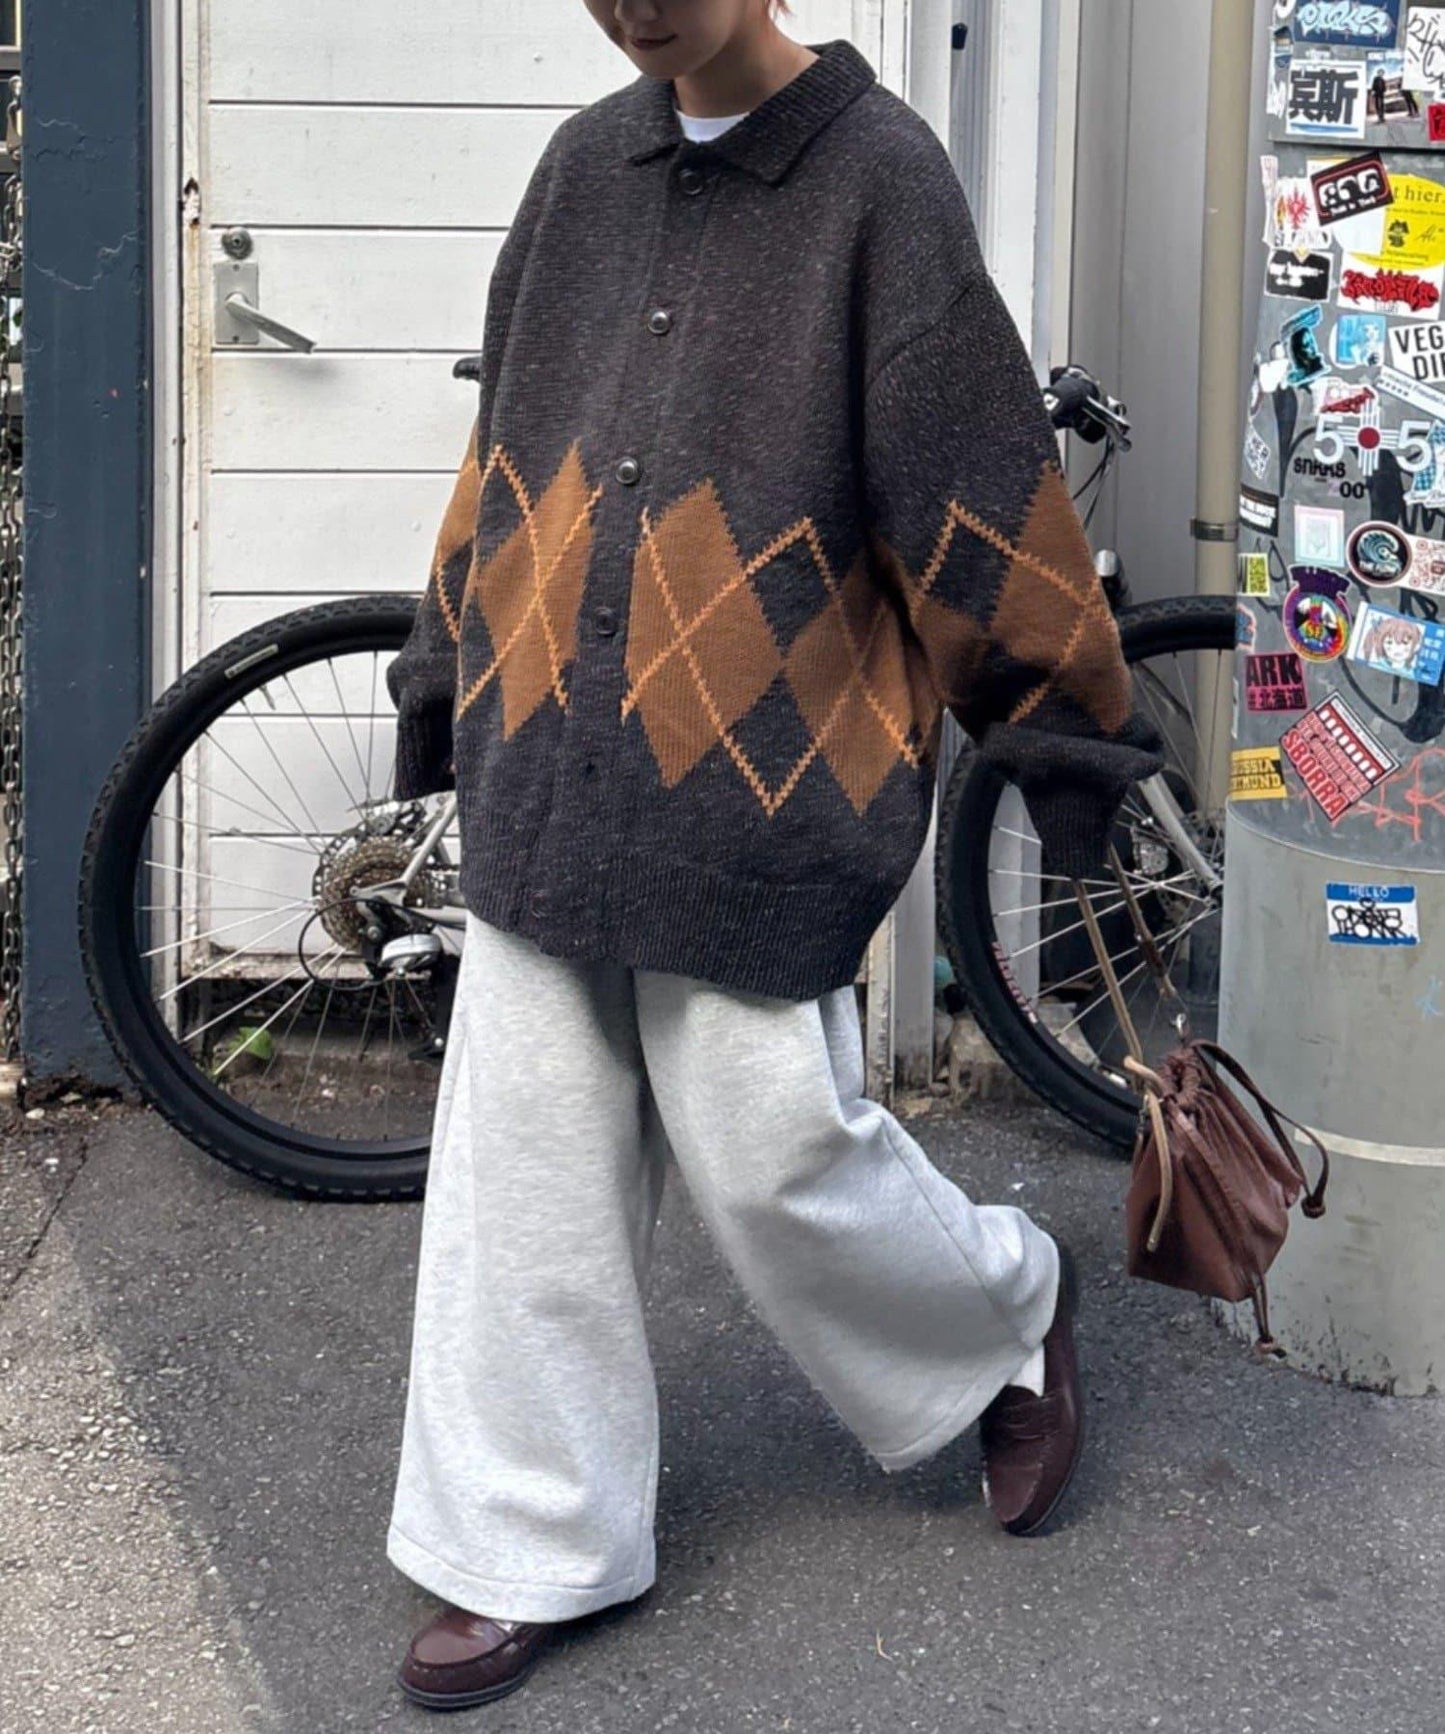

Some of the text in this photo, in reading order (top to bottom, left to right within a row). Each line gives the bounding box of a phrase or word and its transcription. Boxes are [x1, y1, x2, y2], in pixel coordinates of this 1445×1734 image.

[1394, 325, 1444, 354] VEG
[1246, 653, 1303, 687] ARK
[1281, 728, 1349, 819] SBORRA
[1348, 886, 1390, 898] HELLO
